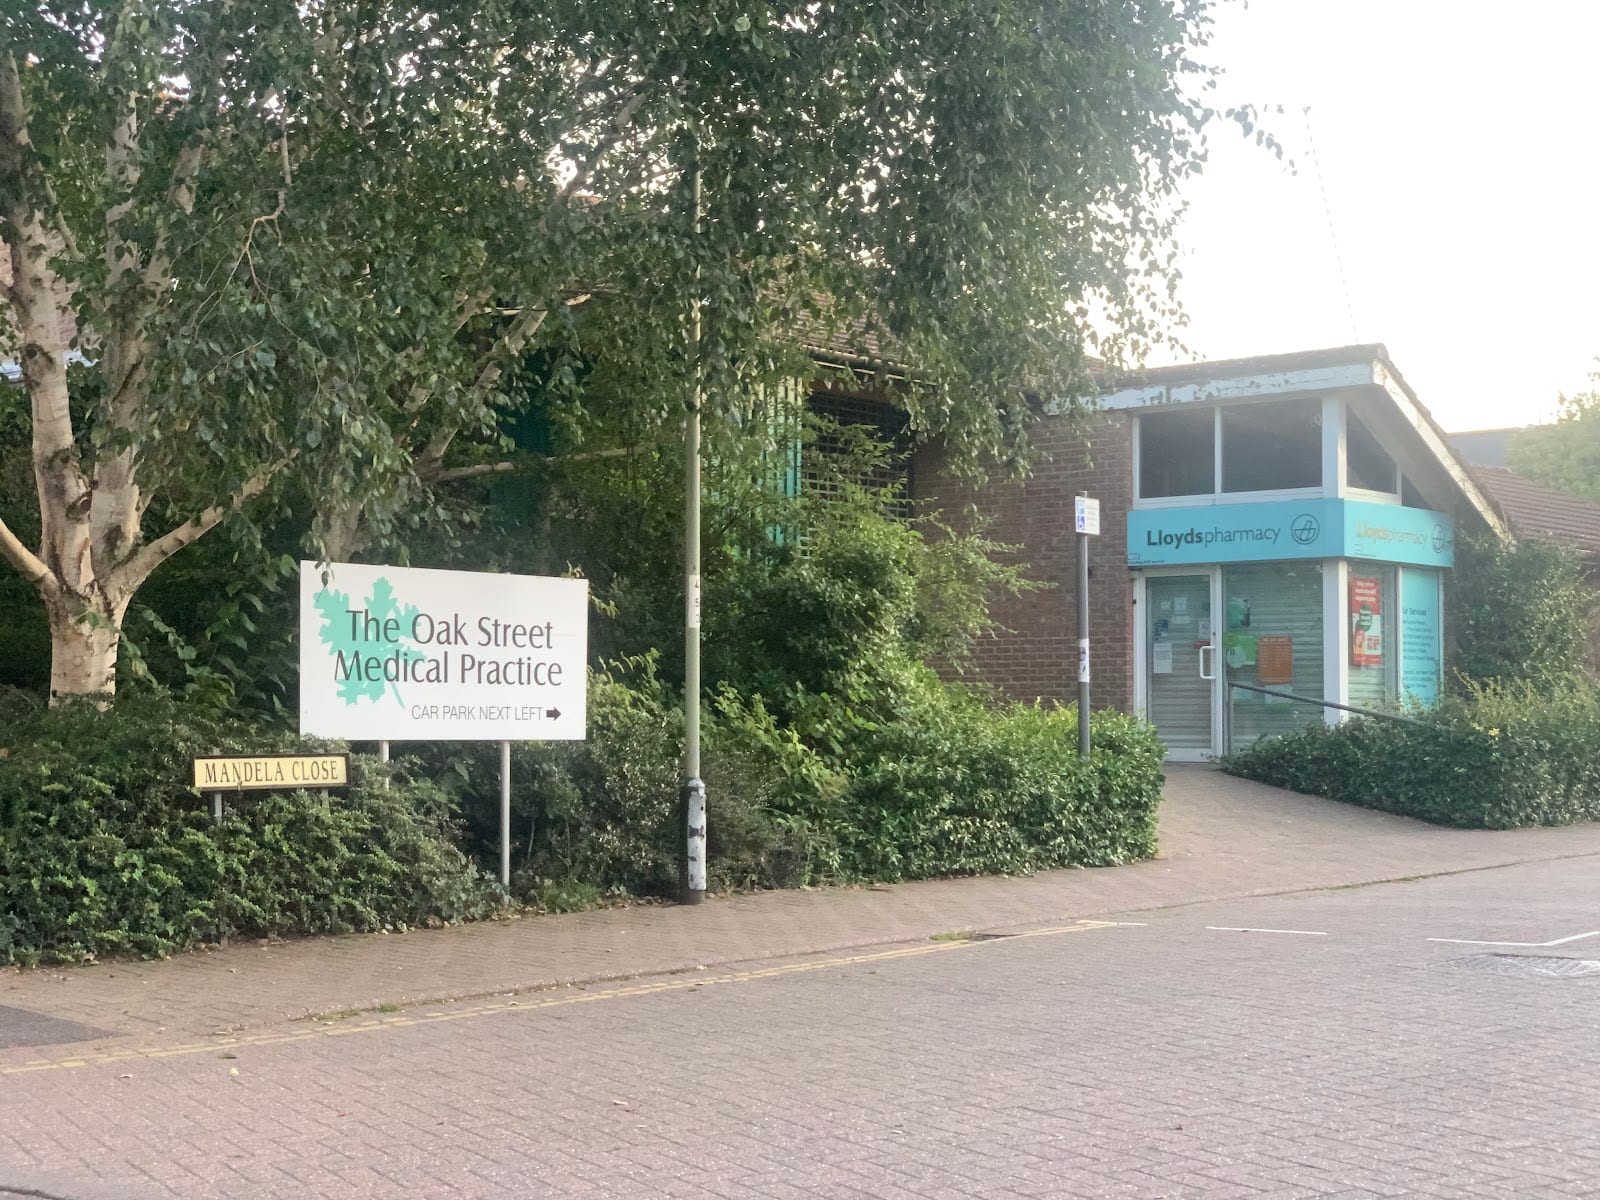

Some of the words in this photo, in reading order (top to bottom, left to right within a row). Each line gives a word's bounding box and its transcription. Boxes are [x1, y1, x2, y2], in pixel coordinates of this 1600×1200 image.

[1147, 526, 1281, 549] Lloydspharmacy
[345, 609, 400, 642] The
[412, 613, 468, 646] Oak
[477, 616, 553, 649] Street
[334, 650, 449, 683] Medical
[460, 653, 562, 686] Practice
[411, 705, 439, 720] CAR
[442, 705, 476, 720] PARK
[479, 706, 512, 720] NEXT
[514, 706, 544, 721] LEFT
[205, 761, 285, 783] MANDELA
[292, 760, 338, 780] CLOSE
